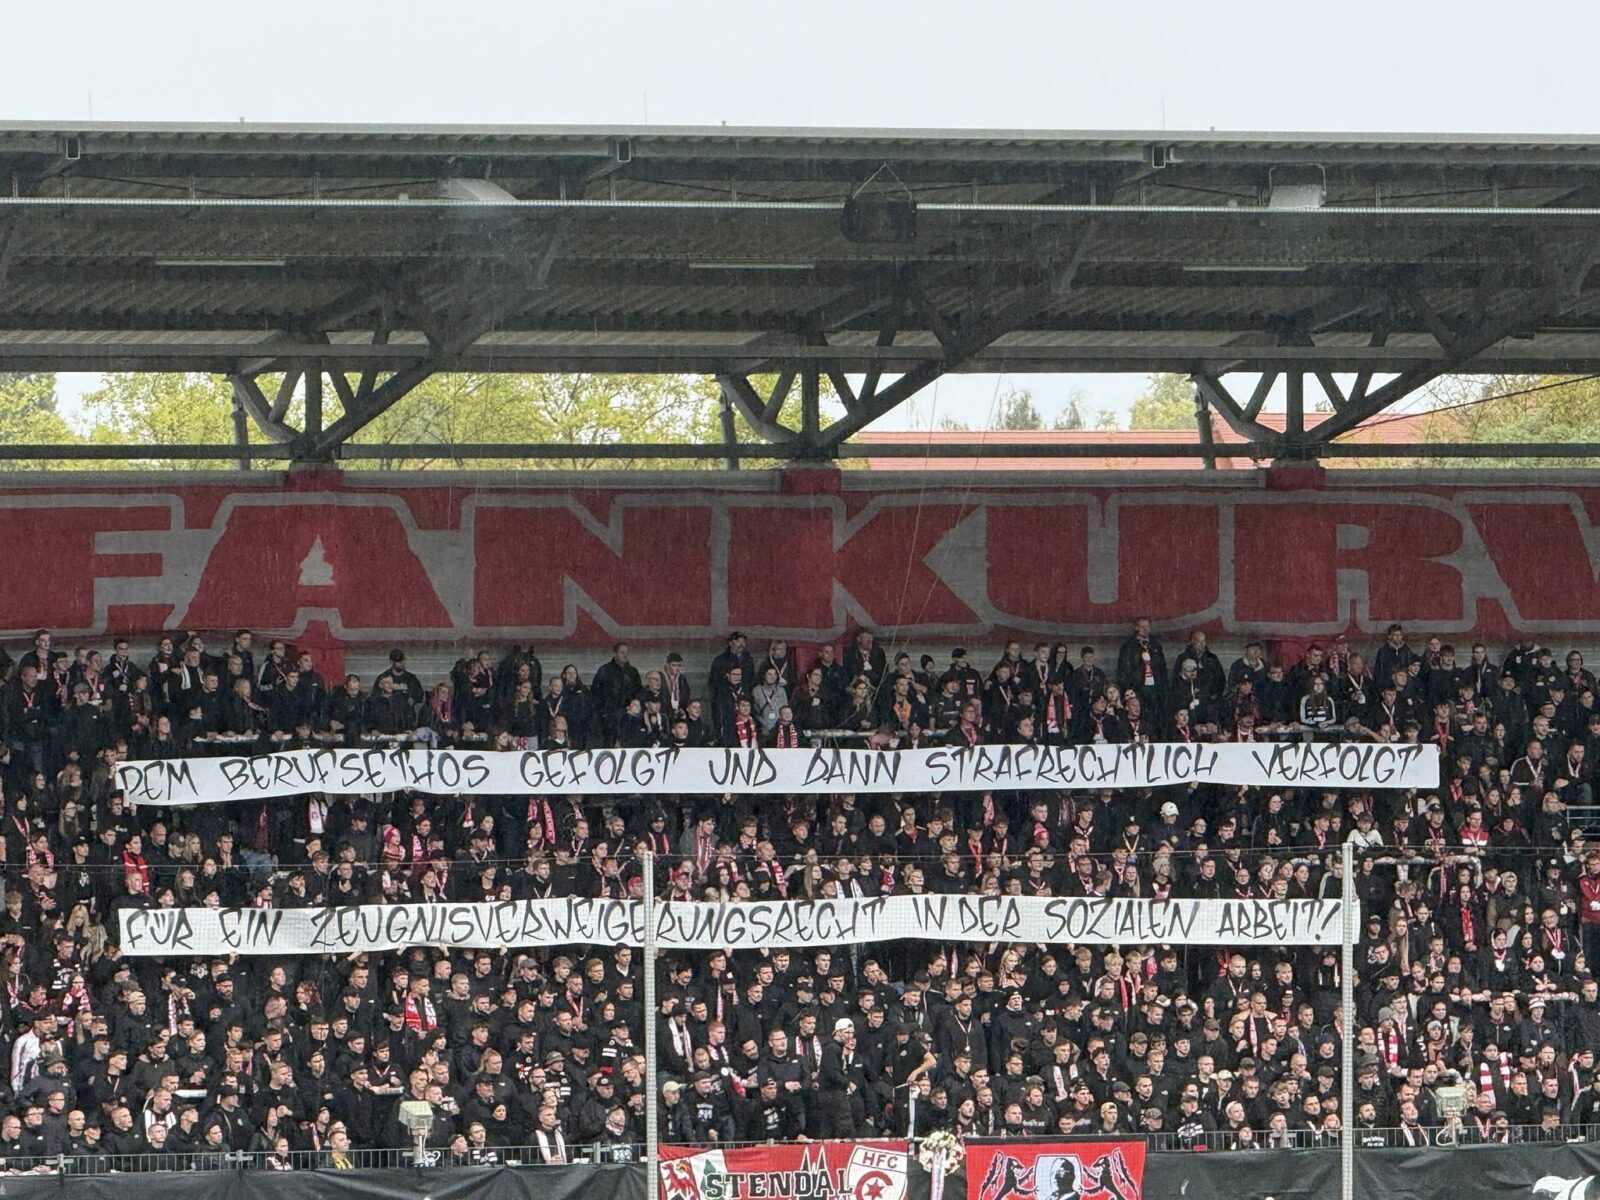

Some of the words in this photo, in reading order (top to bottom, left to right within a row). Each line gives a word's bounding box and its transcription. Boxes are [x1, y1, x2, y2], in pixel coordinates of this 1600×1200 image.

[119, 760, 199, 801] DEM
[220, 748, 490, 795] BERUFSETHOS
[520, 749, 680, 788] GEFOLGT
[708, 748, 777, 787] UND
[801, 746, 900, 787] DANN
[925, 743, 1218, 786] STRAFRECHTLICH
[1252, 743, 1423, 783] VERFOLGT
[126, 908, 194, 950] FÜR
[218, 908, 282, 948] EIN
[310, 896, 885, 948] ZEUGNISVERWEIGERUNGSRECHT
[913, 896, 947, 931] IN
[959, 895, 1022, 939] DER
[1044, 897, 1199, 940] SOZIALEN
[1216, 898, 1341, 941] ARBEIT!
[862, 1151, 899, 1170] HFC
[704, 1168, 854, 1200] STENDAL
